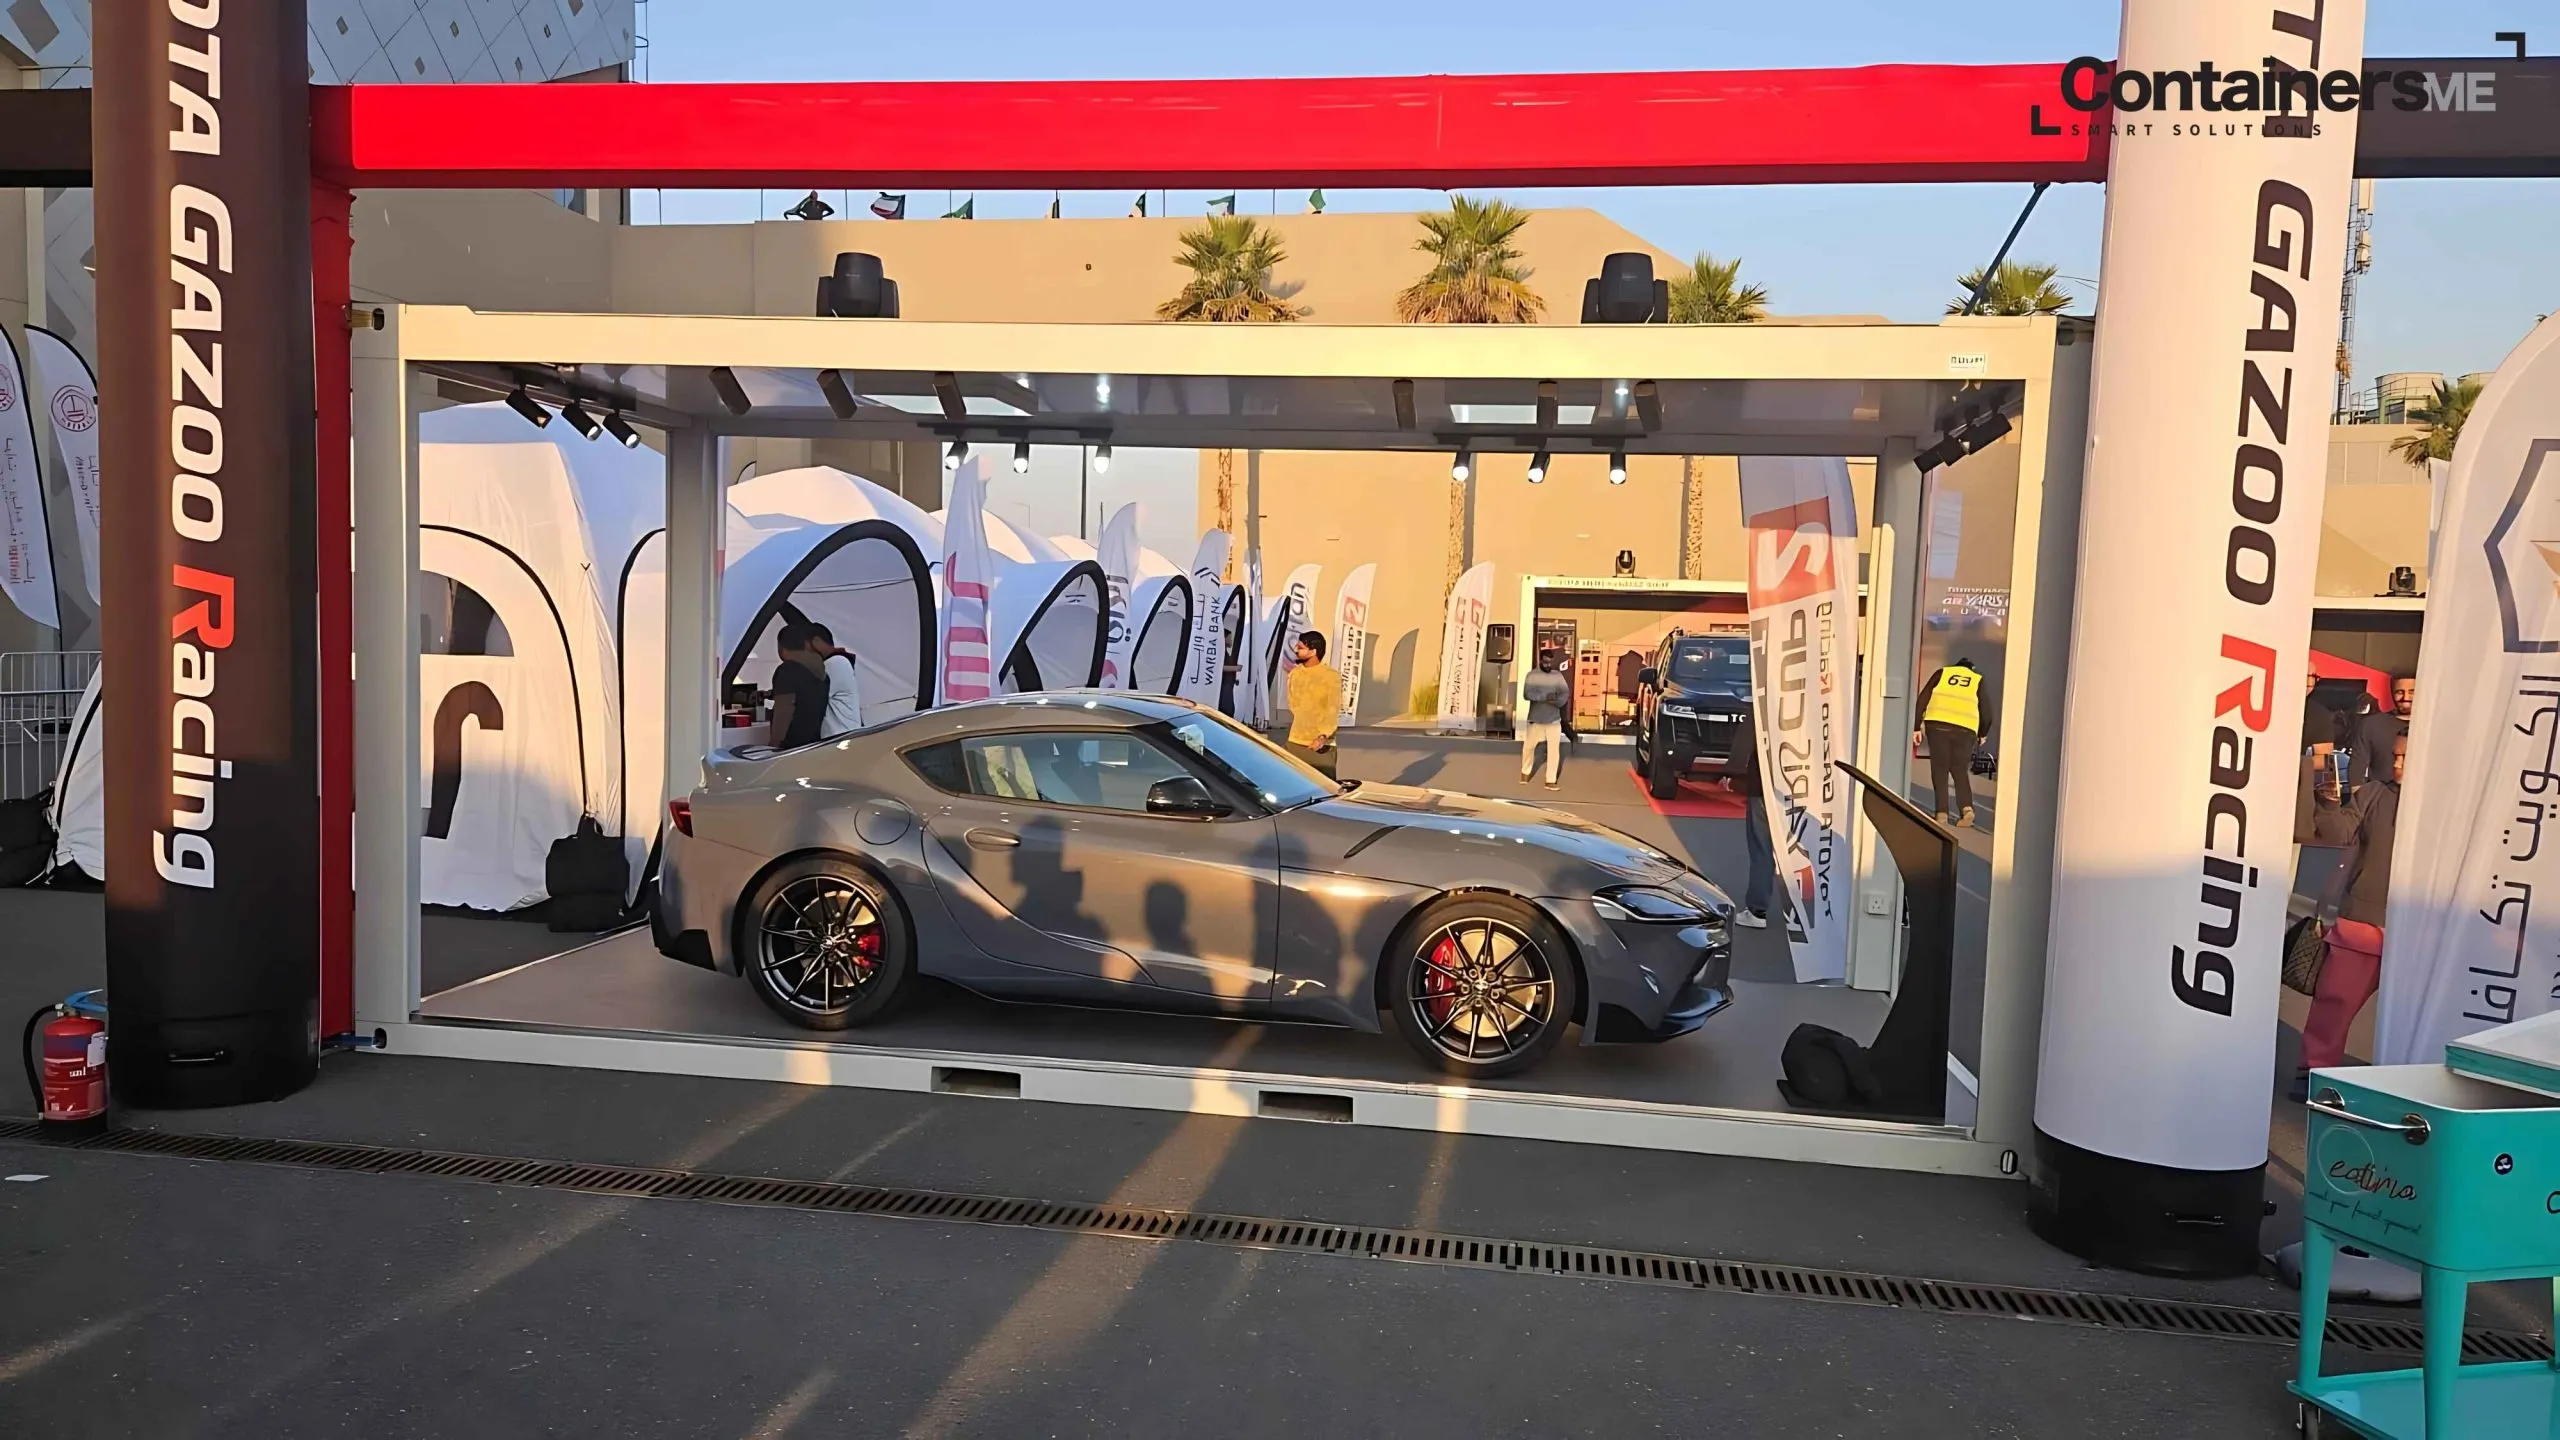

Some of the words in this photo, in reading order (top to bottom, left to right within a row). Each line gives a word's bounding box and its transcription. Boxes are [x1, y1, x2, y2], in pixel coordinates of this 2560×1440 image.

[170, 184, 233, 542] GAZOO
[2225, 179, 2315, 606] GAZOO
[153, 563, 235, 889] Racing
[1205, 638, 1218, 686] WARBA
[1209, 595, 1222, 633] BANK
[1948, 674, 1972, 688] 63
[2171, 633, 2277, 1018] Racing
